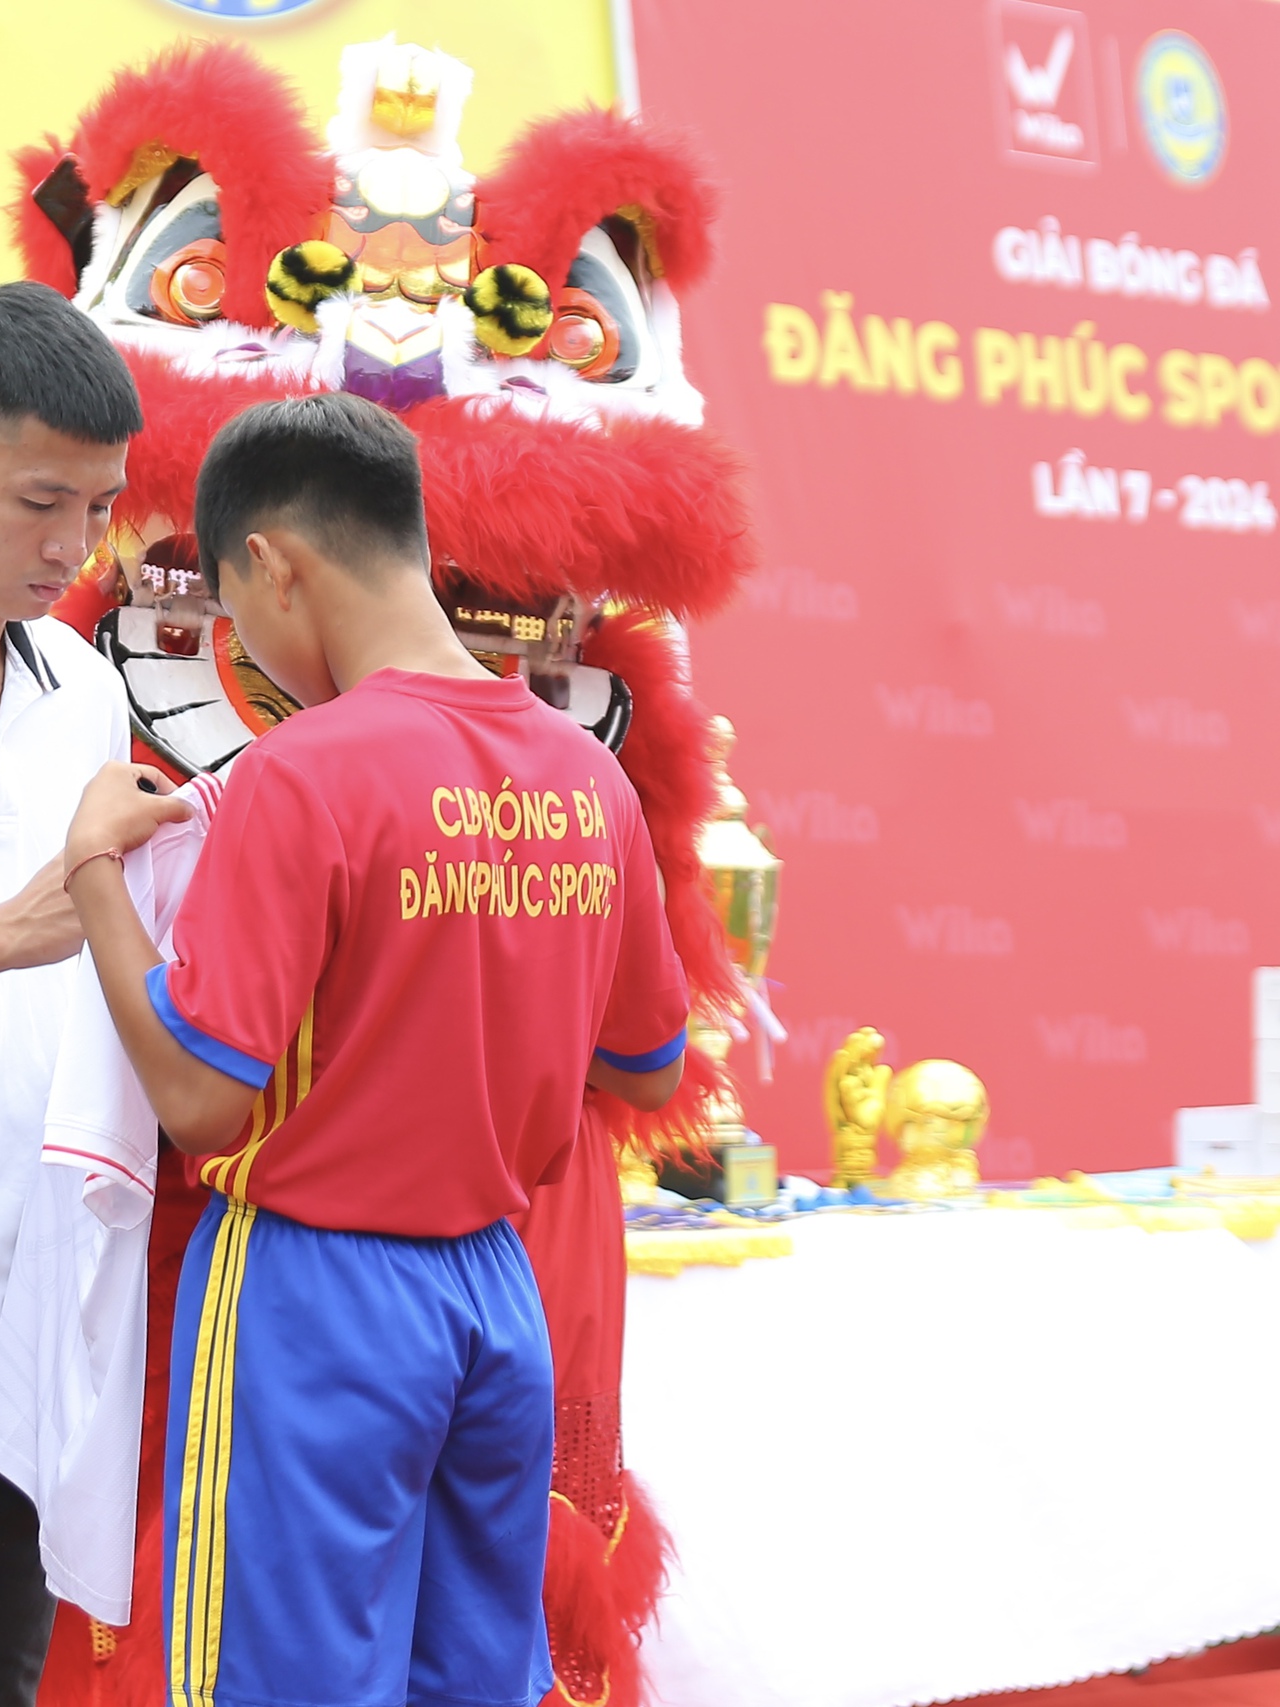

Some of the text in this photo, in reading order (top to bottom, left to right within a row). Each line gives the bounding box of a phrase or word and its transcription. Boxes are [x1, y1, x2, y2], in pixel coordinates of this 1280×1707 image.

[993, 214, 1271, 313] GIẢI BÓNG ĐÁ
[761, 289, 965, 402] ĐĂNG
[974, 320, 1152, 424] PHÚC
[1032, 447, 1278, 534] LẦN 7 - 2024
[432, 786, 483, 837] CLB
[571, 776, 607, 840] ĐÁ
[400, 850, 478, 920] ĐĂNG
[475, 848, 544, 918] PHÚC
